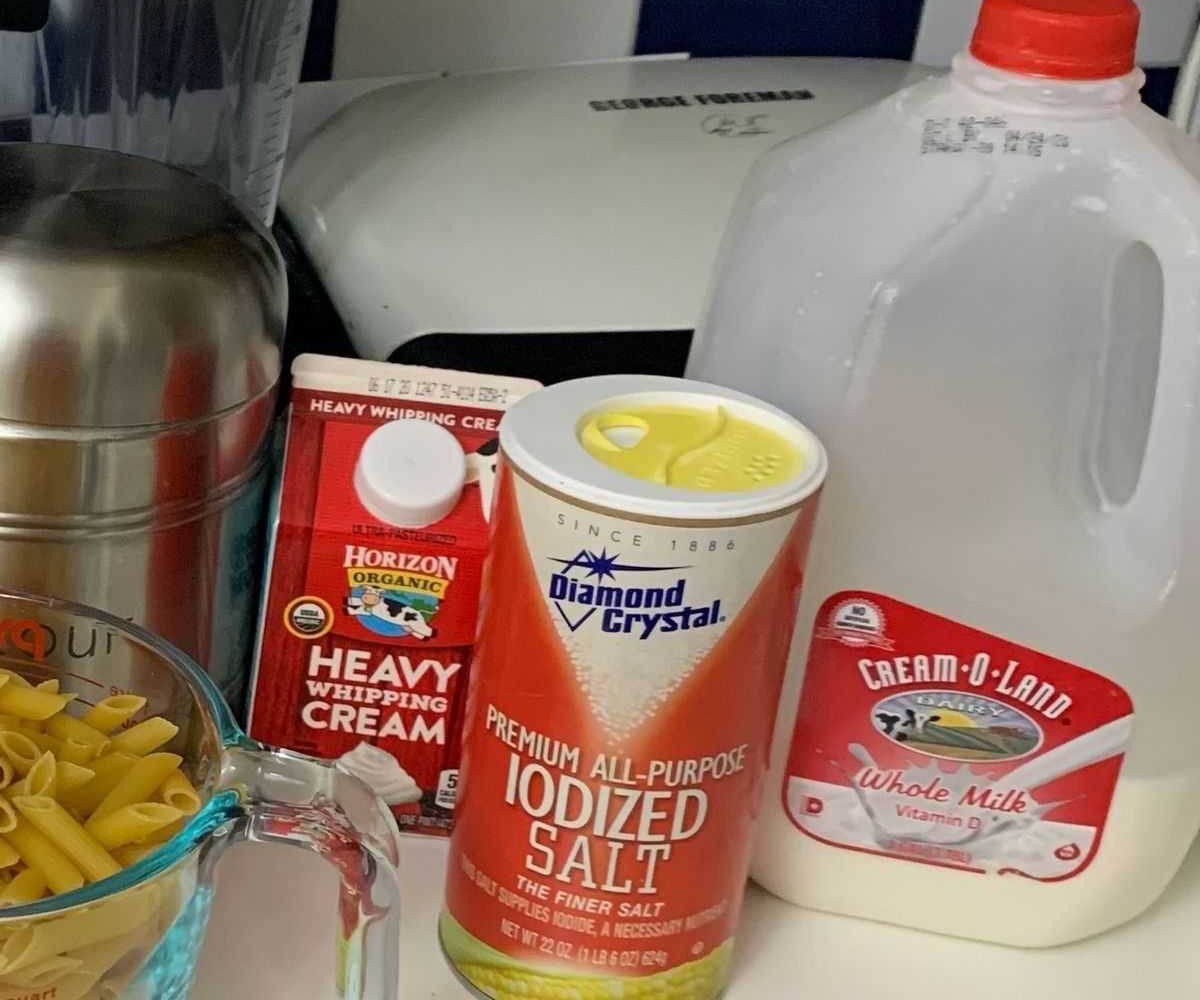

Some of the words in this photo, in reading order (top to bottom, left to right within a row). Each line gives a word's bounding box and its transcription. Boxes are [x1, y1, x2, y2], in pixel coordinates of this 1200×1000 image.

[310, 399, 366, 416] HEAVY
[557, 514, 642, 546] SINCE
[671, 540, 735, 551] 1886
[342, 545, 458, 580] HORIZON
[353, 572, 442, 593] ORGANIC
[549, 574, 686, 608] Diamond
[602, 600, 721, 640] Crystal
[308, 646, 461, 693] HEAVY
[306, 680, 448, 713] WHIPPING
[916, 696, 1006, 717] DAIRY
[302, 701, 445, 745] CREAM
[486, 704, 579, 773] PREMIUM
[591, 744, 747, 787] ALL-PURPOSE
[505, 753, 707, 842] IODIZED
[859, 768, 950, 801] Whole
[959, 785, 1028, 814] Milk
[896, 804, 962, 827] Vitamin
[968, 817, 982, 830] D
[525, 821, 670, 894] SALT
[499, 887, 550, 923] SUPPLIES
[601, 921, 610, 937] A
[614, 917, 683, 938] NECESSARY
[517, 874, 551, 900] THE
[554, 890, 612, 915] FINER
[618, 902, 665, 917] SALT
[501, 918, 520, 940] NET
[522, 928, 539, 947] WT
[540, 937, 554, 954] 22
[557, 941, 573, 959] OZ
[592, 949, 607, 964] LB
[610, 950, 617, 966] 6
